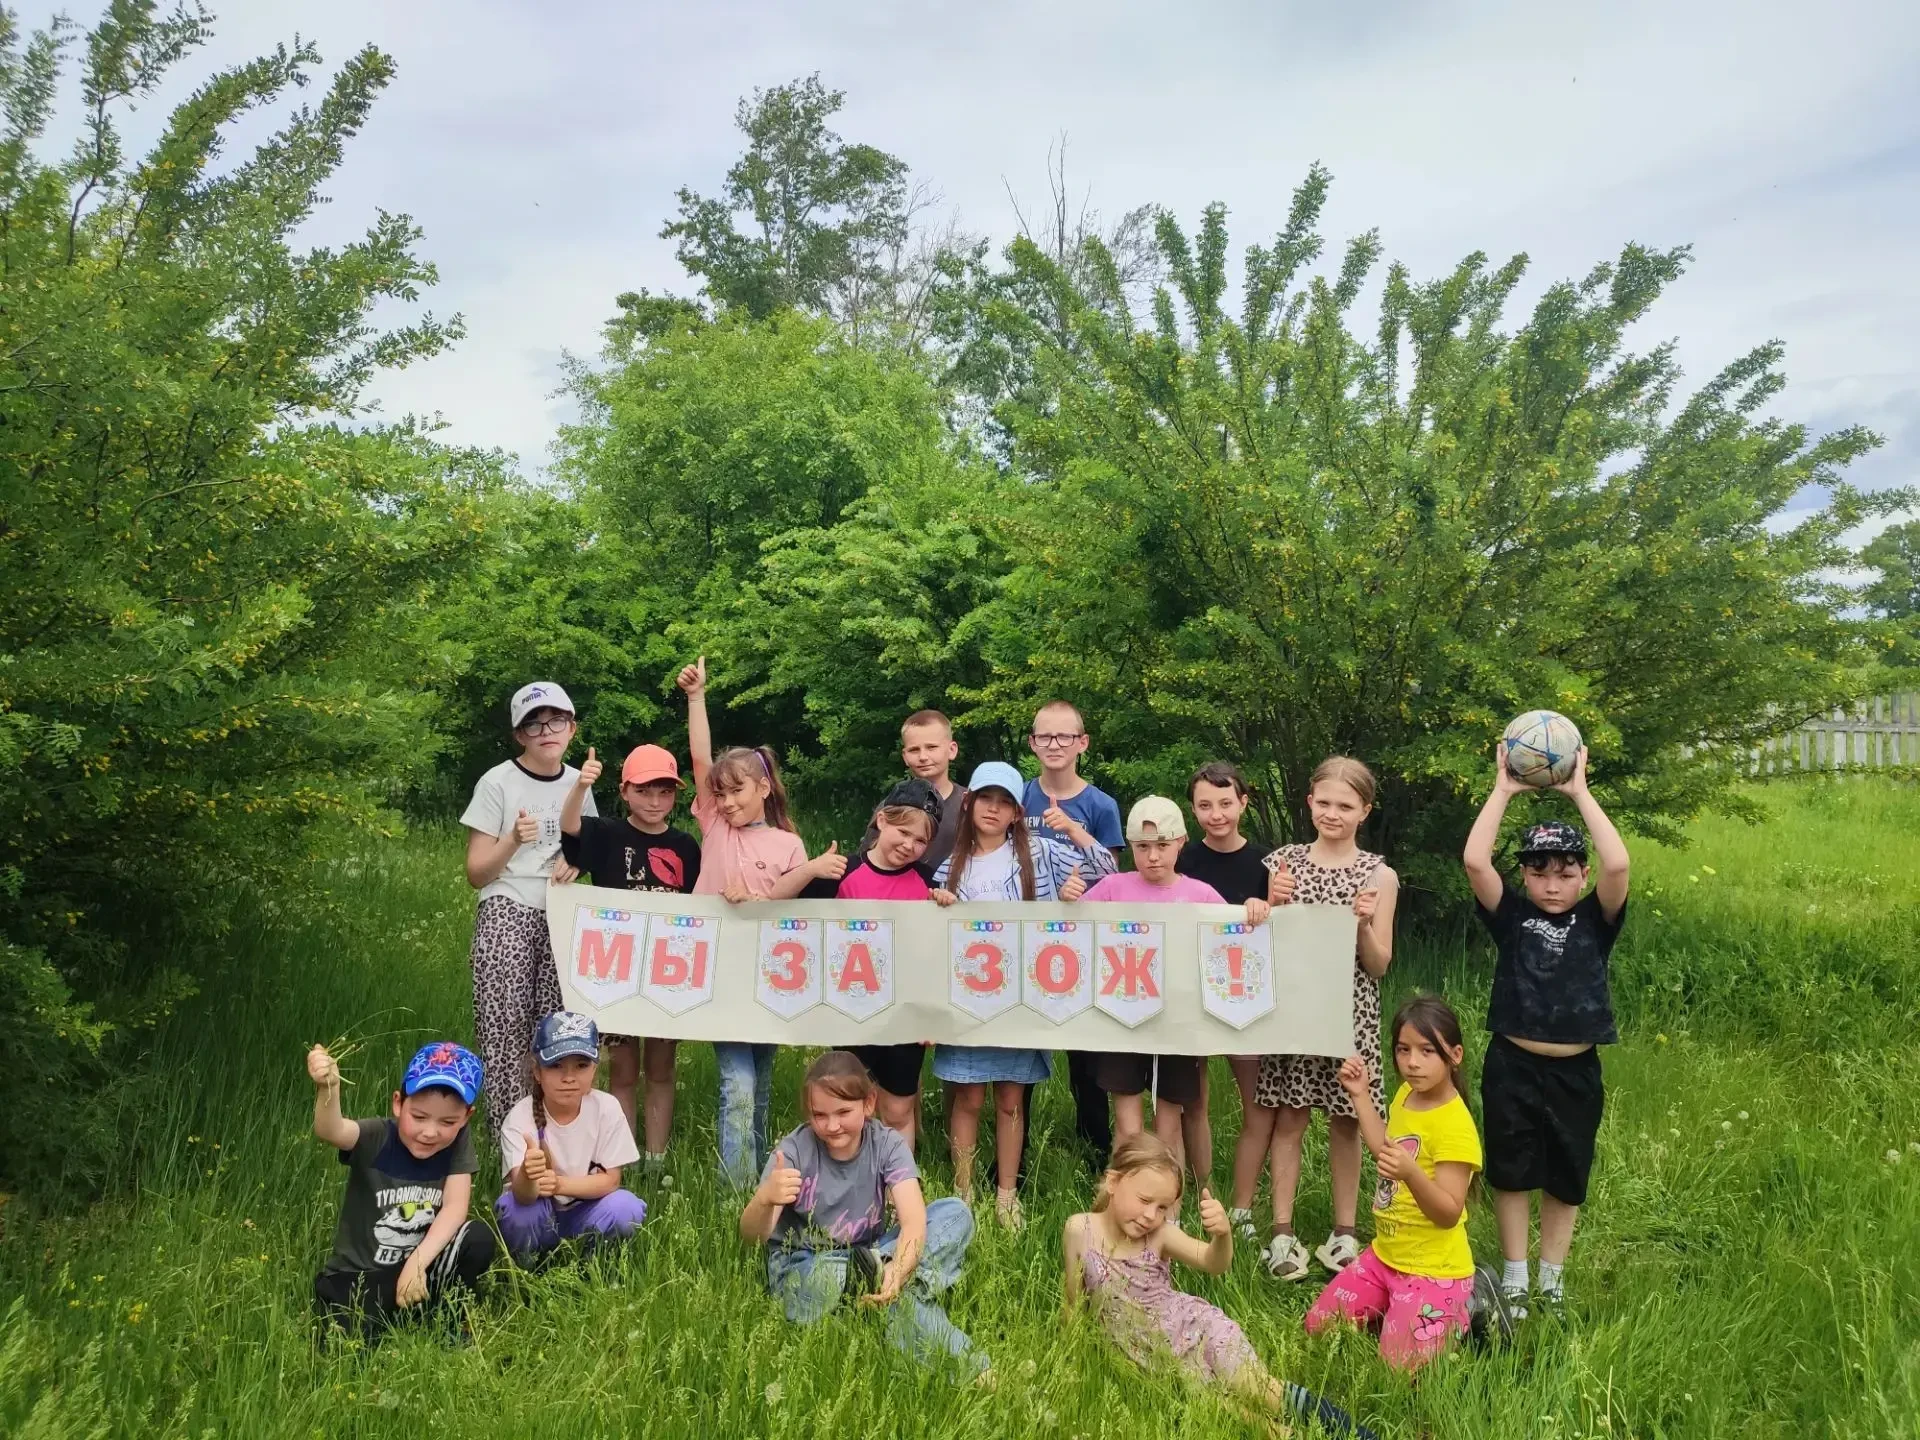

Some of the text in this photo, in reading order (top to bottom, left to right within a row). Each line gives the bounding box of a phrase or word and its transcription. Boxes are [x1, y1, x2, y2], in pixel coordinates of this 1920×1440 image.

[577, 928, 708, 989] МЫ
[768, 941, 881, 992] ЗА
[962, 943, 1160, 998] ЗОЖ
